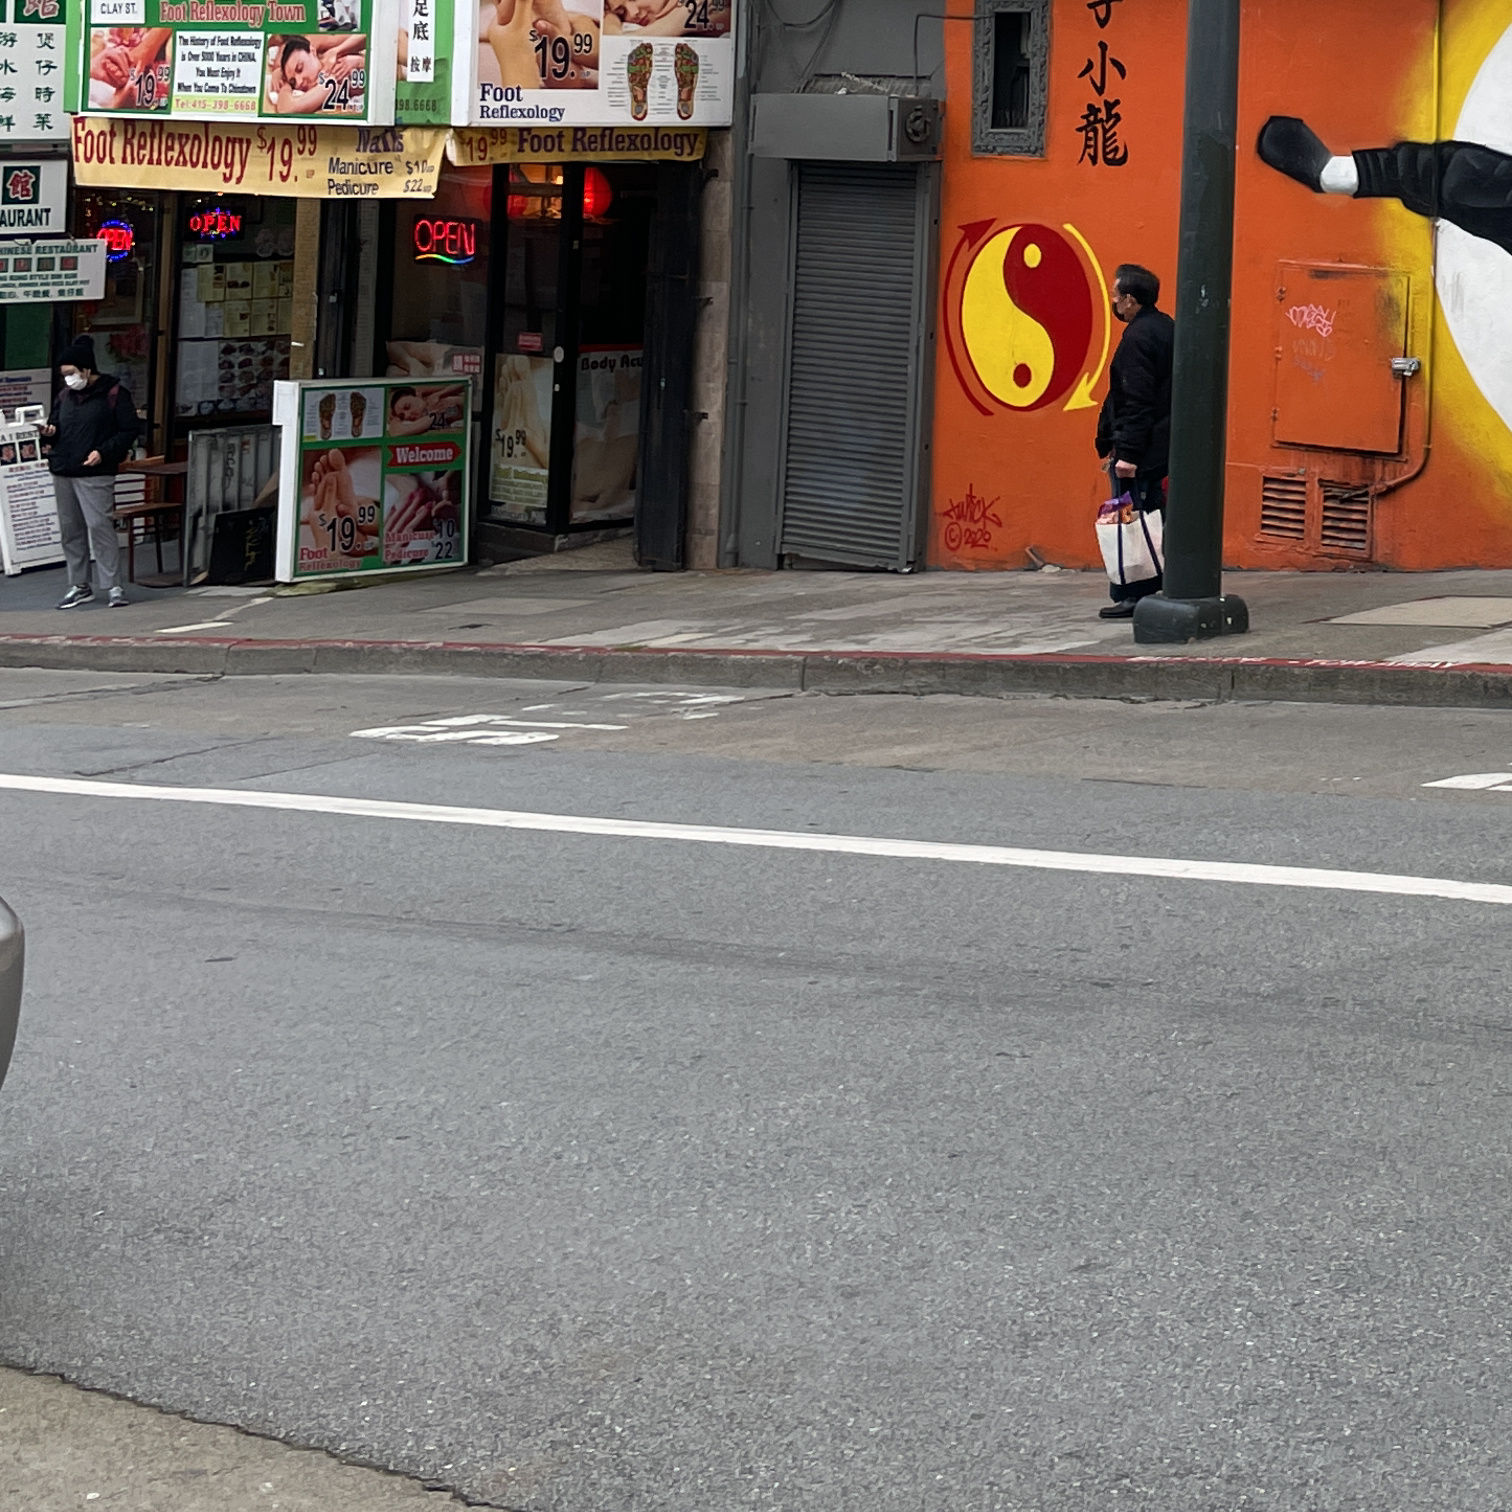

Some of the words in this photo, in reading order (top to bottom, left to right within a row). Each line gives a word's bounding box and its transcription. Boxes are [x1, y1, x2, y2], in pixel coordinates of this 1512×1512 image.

[101, 3, 123, 15] CLAY
[125, 3, 138, 15] ST.
[160, 0, 187, 22] Foot
[189, 0, 266, 28] Reflexology
[267, 0, 306, 23] Town
[479, 82, 524, 103] Foot
[479, 104, 566, 123] Reflexology
[72, 117, 116, 165] Foot
[121, 119, 252, 185] Reflexology
[516, 128, 566, 154] Foot
[570, 128, 700, 157] Reflexology
[328, 157, 394, 175] Manicure
[6, 170, 36, 200] 館
[327, 178, 380, 195] Pedicure
[190, 213, 242, 234] OPEN
[414, 219, 477, 256] OPEN
[581, 356, 617, 373] Body
[395, 446, 454, 464] Welcome
[301, 547, 328, 561] Foot
